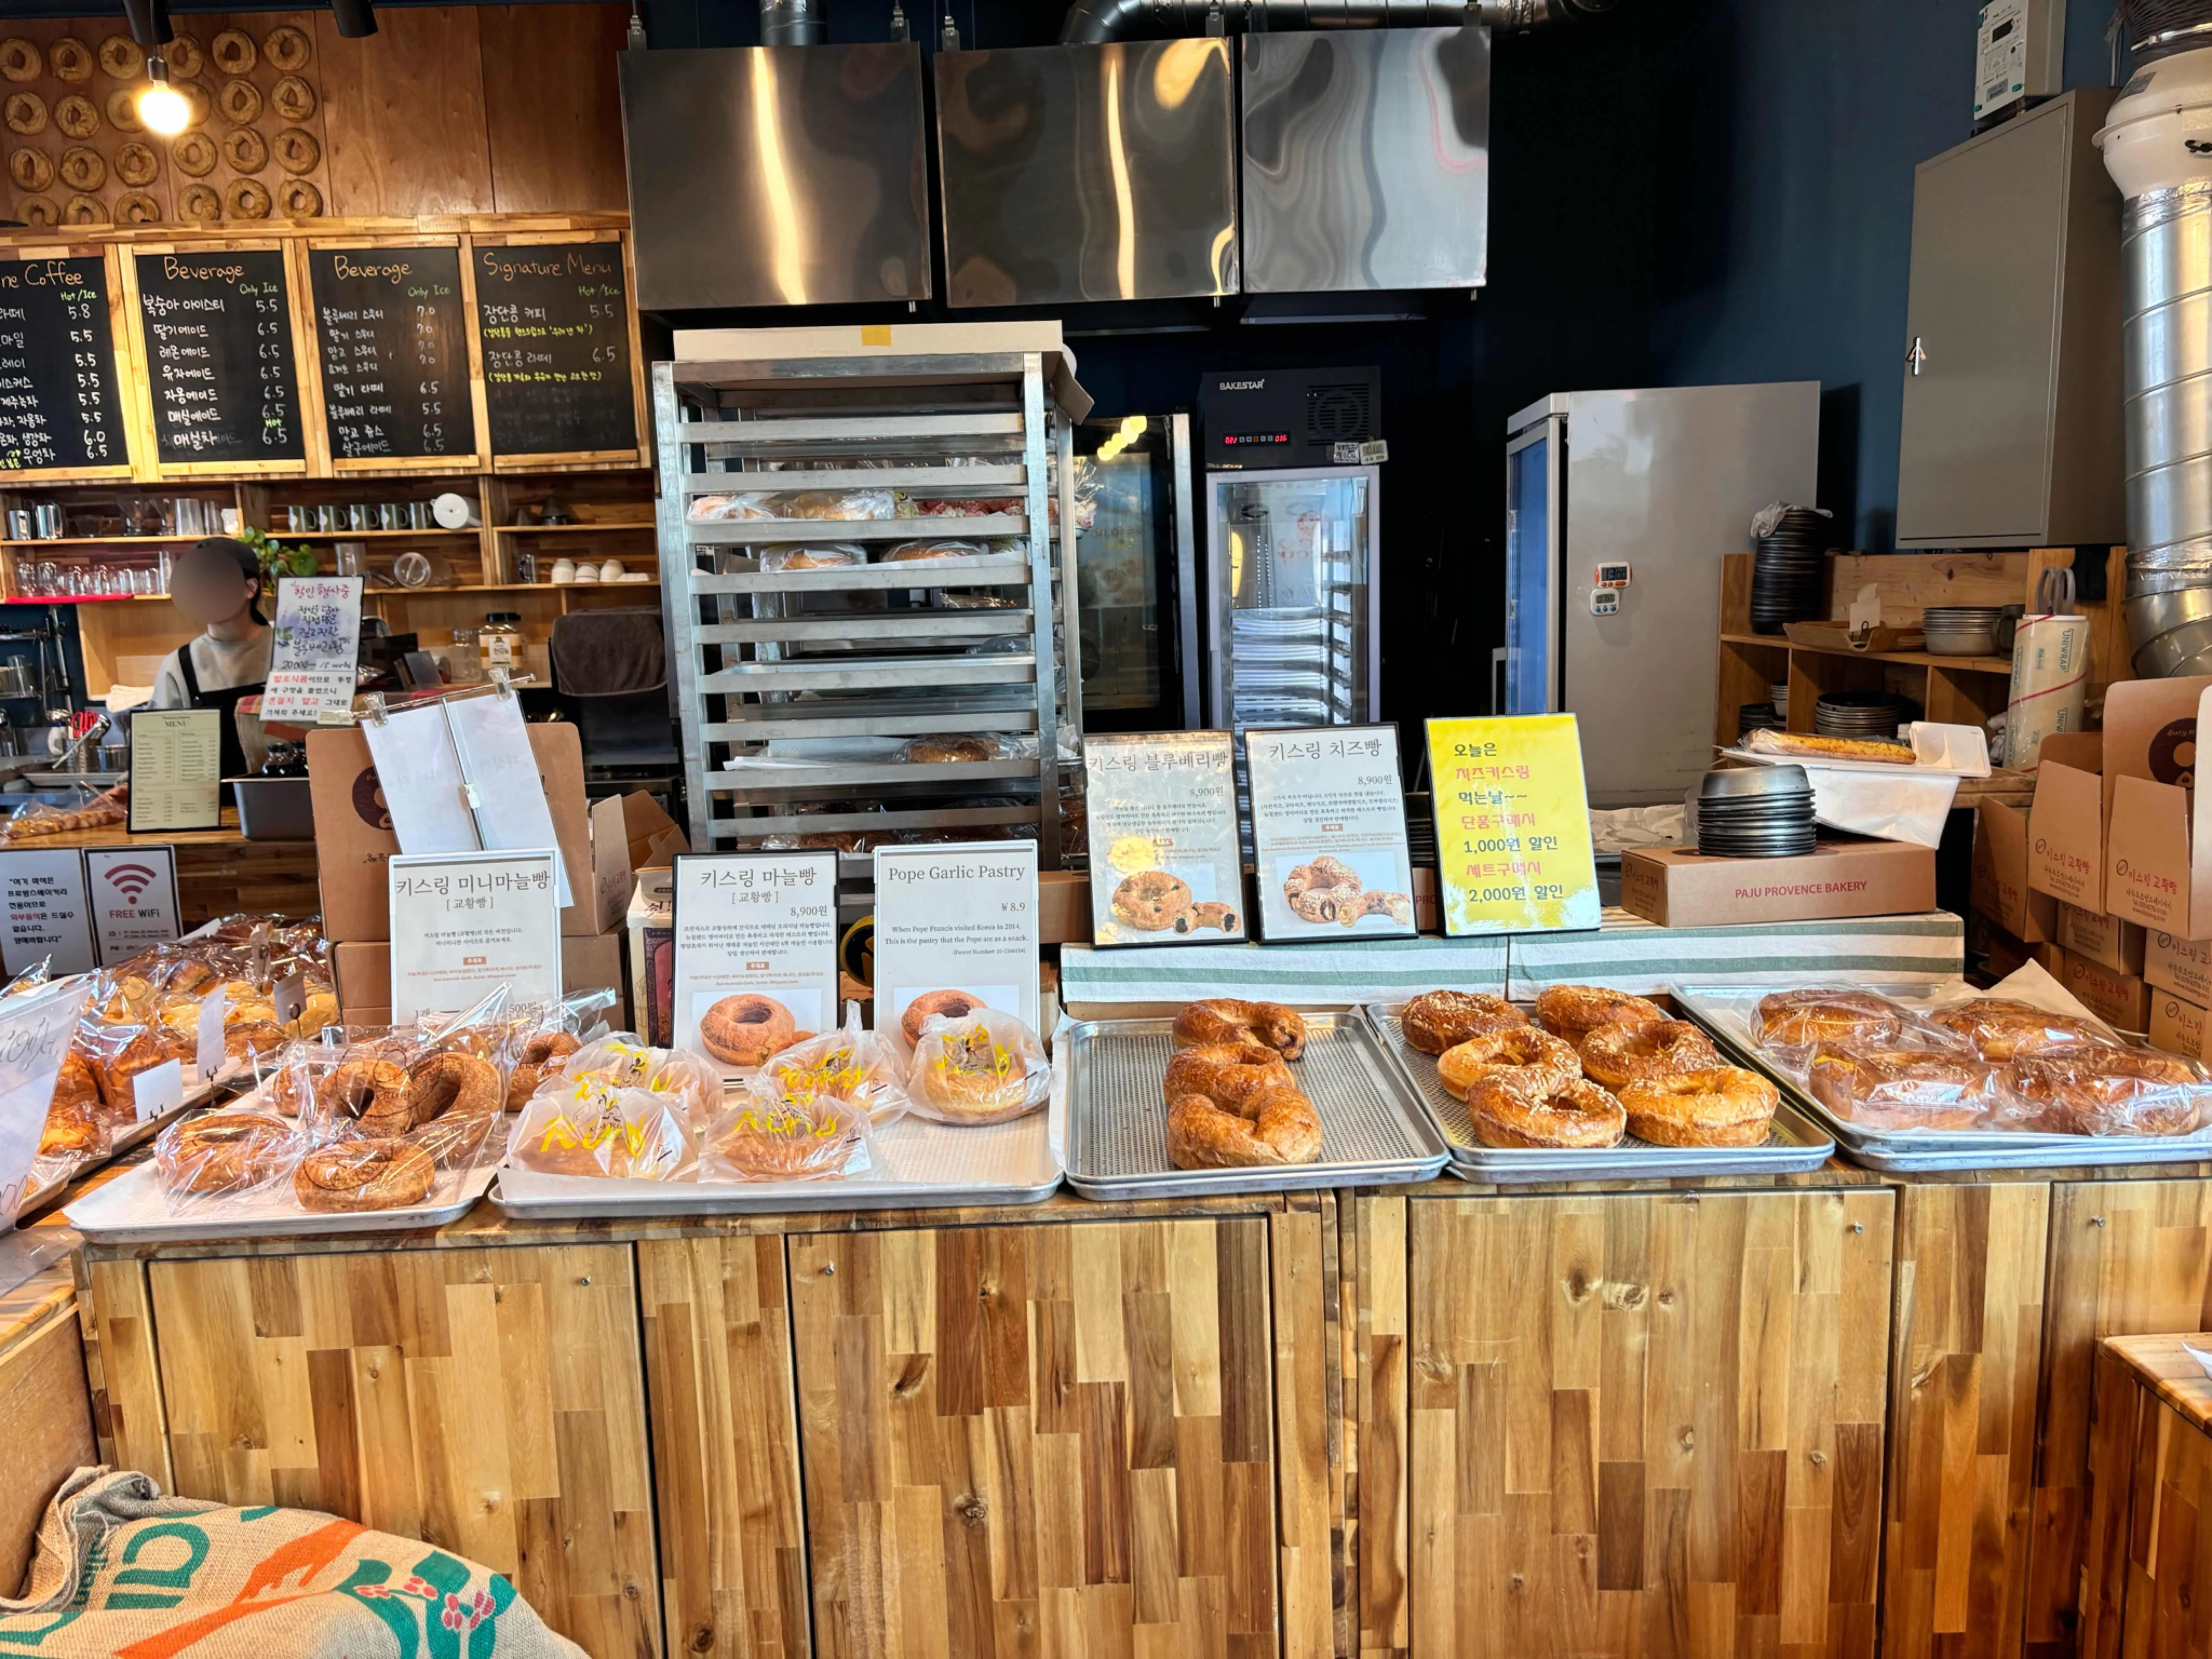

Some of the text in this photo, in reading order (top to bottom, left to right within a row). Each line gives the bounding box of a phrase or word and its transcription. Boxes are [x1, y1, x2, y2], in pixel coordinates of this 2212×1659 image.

[24, 261, 84, 286] Coffee
[164, 256, 244, 284] Beverage
[334, 255, 413, 284] Beverage
[484, 252, 612, 281] Signature Menu
[239, 282, 278, 296] Only Ice
[408, 285, 451, 299] Only Ice
[68, 303, 90, 319] 5.8
[143, 293, 278, 316] 복숭아 아이스티 5.5
[483, 304, 518, 324] 장단콩
[590, 304, 613, 318] 5.5
[70, 329, 93, 342] 5.5
[257, 322, 278, 335] 6.5
[75, 352, 96, 367] 5.5
[259, 344, 280, 359] 6.5
[488, 350, 523, 368] 장단콩
[592, 346, 616, 363] 6.5
[77, 372, 100, 388] 5.5
[260, 366, 281, 379] 6.5
[264, 386, 284, 399] 6.5
[333, 381, 439, 398] 딸기 라떼 6.5
[1219, 379, 1264, 390] BAKESTAR
[78, 392, 100, 406] 5.5
[262, 403, 286, 418] 6.5
[422, 402, 441, 415] 5.5
[81, 412, 102, 423] 5.5
[84, 430, 105, 445] 6.0
[262, 427, 287, 445] 6.5
[423, 423, 442, 438] 6.5
[86, 444, 107, 459] 6.5
[424, 438, 444, 453] 6.5
[2059, 630, 2072, 671] UNIWRAP
[1269, 738, 1382, 760] 키스링 치즈빵
[1455, 742, 1497, 757] 오늘은
[1088, 751, 1228, 772] 키스링 블루베리빵
[1357, 774, 1393, 787] 8,900원
[1456, 765, 1530, 781] 치즈키스링
[1464, 836, 1558, 854] 1,000원 할인
[701, 867, 817, 888] 키스링 마늘빵
[889, 865, 1025, 884] Pope Garlic Pastry
[1466, 861, 1541, 878] 세트구매시
[396, 870, 550, 897] 키스링 미니마늘빵
[1735, 881, 1867, 899] PAJU PROVENCE BAKERY
[1469, 885, 1563, 903] 2,000원 할인
[109, 908, 160, 918] FREE WiFi
[790, 905, 828, 918] 8,900원
